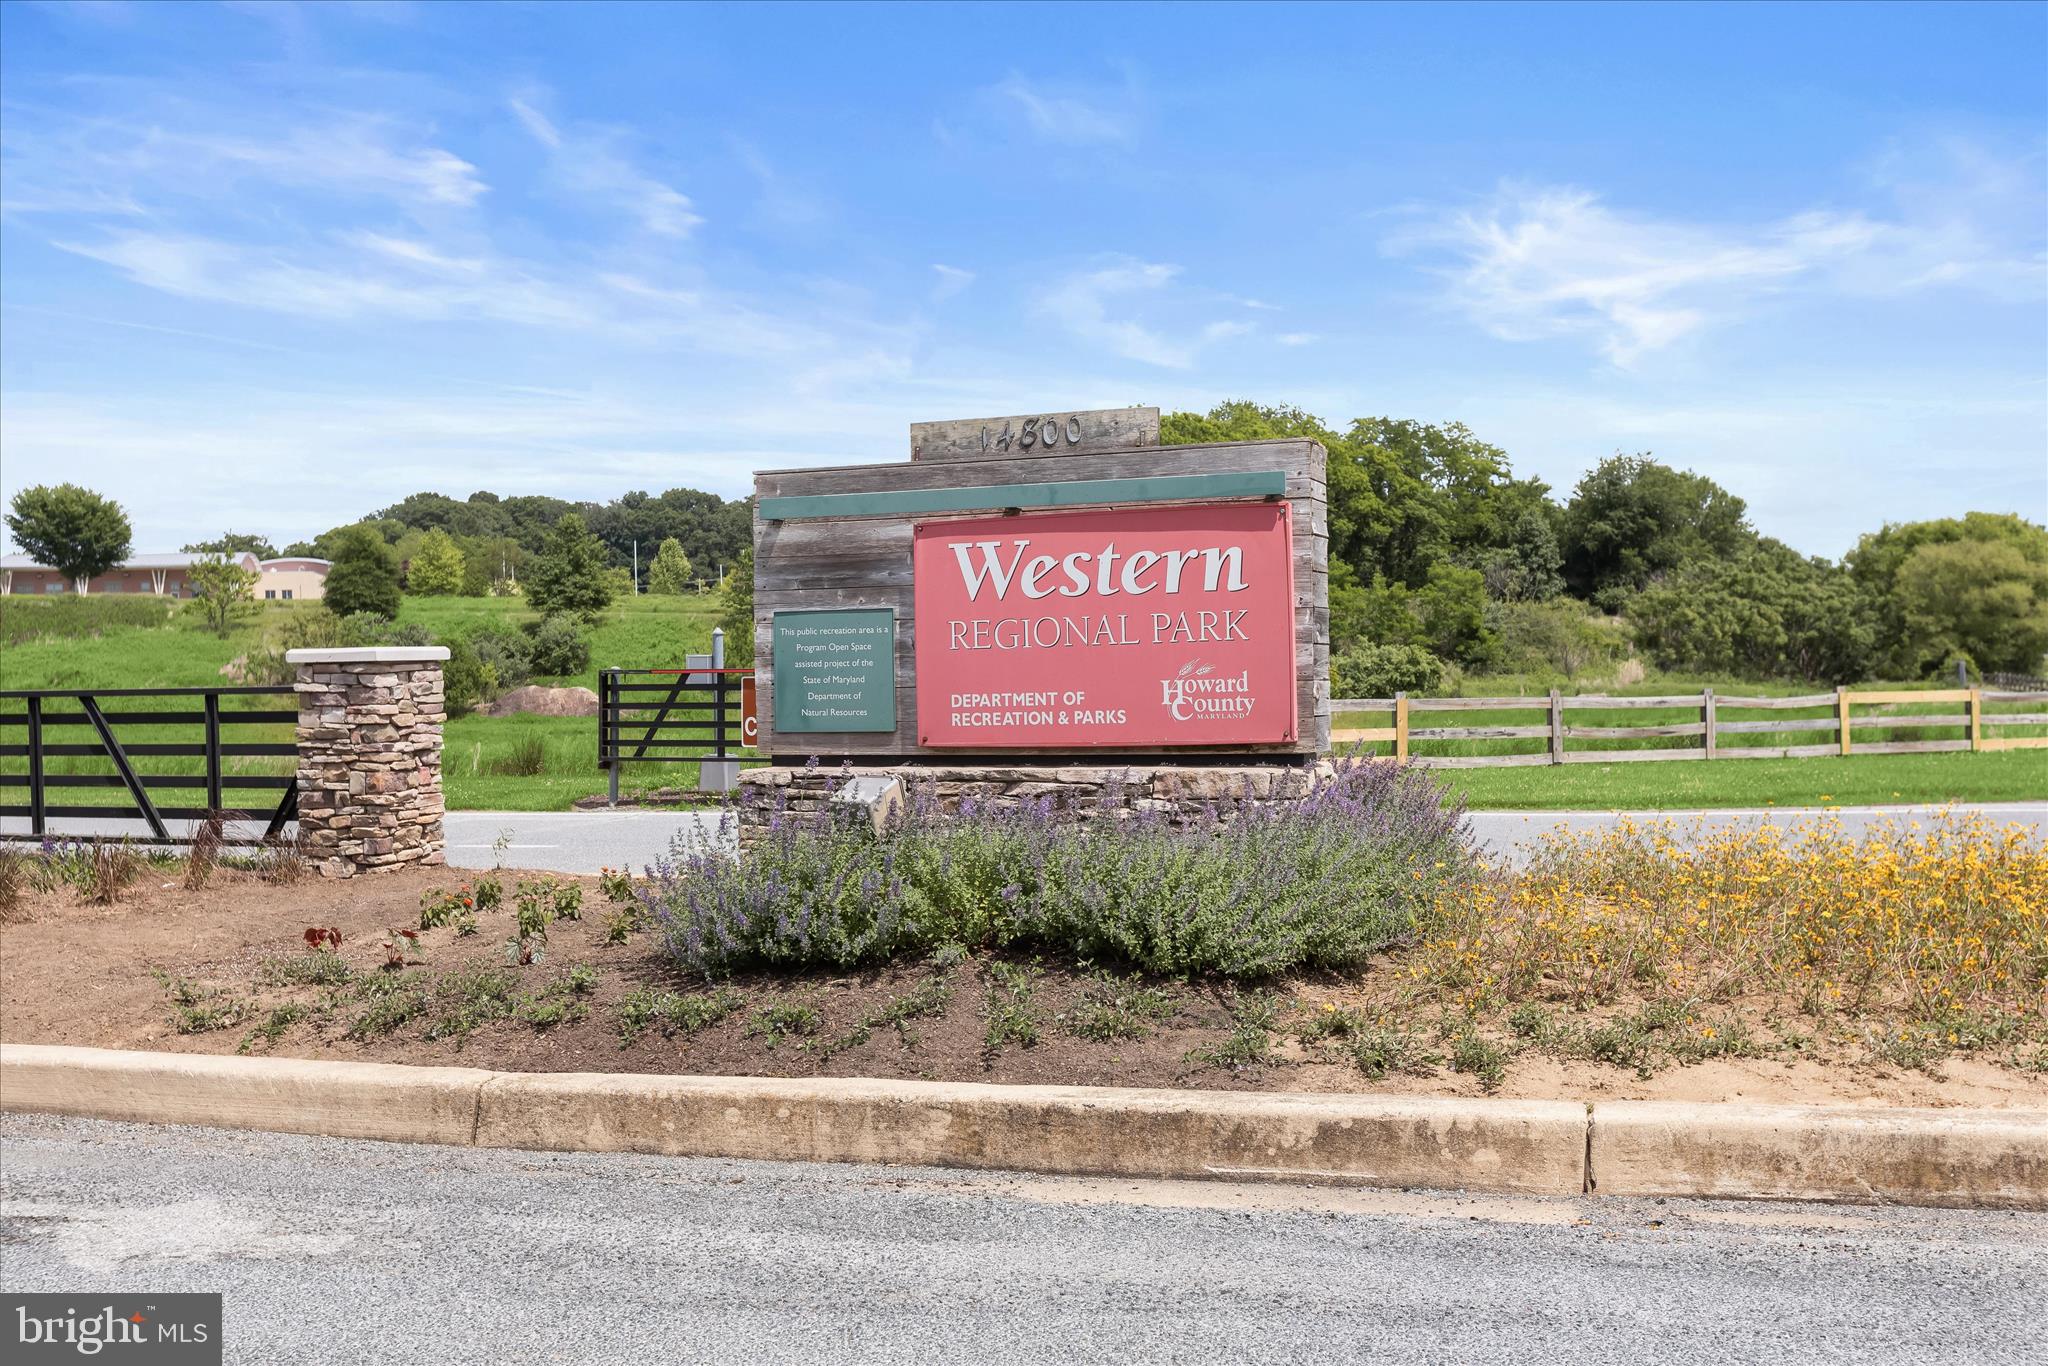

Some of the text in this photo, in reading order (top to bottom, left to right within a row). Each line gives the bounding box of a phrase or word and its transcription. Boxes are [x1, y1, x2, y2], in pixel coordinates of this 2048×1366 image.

[982, 415, 1081, 452] 14800
[948, 540, 1249, 602] Western
[780, 627, 795, 636] This
[796, 627, 818, 637] public
[819, 626, 857, 635] recreation
[948, 609, 1249, 650] REGIONAL PARK
[796, 642, 872, 653] Program Open Space
[794, 659, 822, 668] assisted
[824, 660, 850, 669] project
[861, 659, 873, 667] the
[802, 675, 865, 685] State of Maryland
[1160, 670, 1249, 705] Howard
[807, 692, 861, 701] Department of
[951, 691, 1085, 707] DEPARTMENT OF
[801, 708, 868, 716] Natural Resources
[1171, 695, 1255, 721] County
[951, 709, 1127, 727] RECREATION & PARKS
[1196, 712, 1245, 720] MARYLAND
